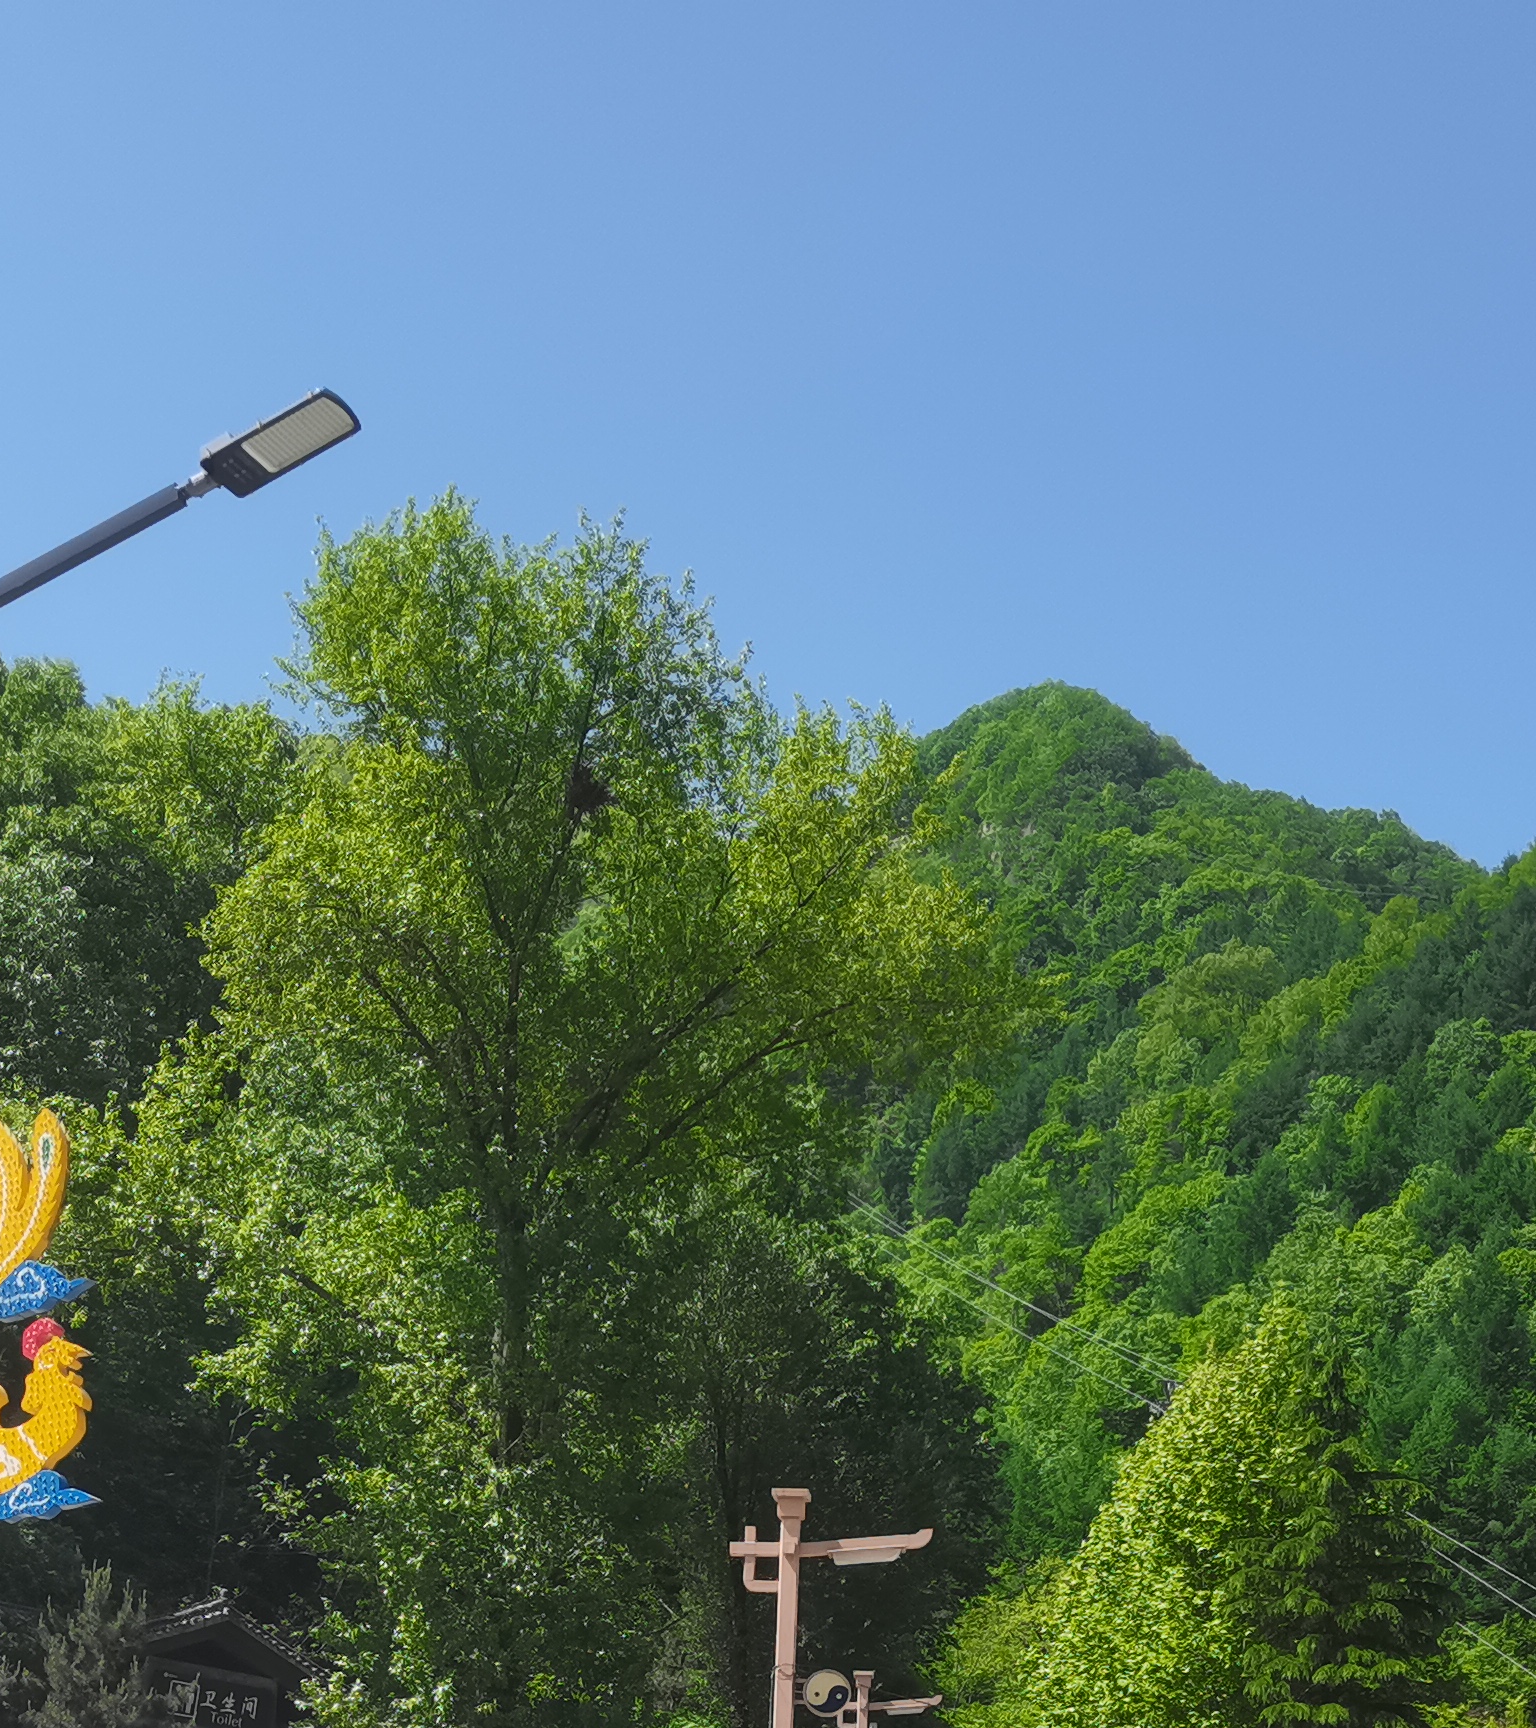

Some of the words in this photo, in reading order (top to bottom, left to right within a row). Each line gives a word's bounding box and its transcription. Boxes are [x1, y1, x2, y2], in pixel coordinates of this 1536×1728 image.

[200, 1690, 258, 1719] 卫生间
[210, 1711, 242, 1728] Toilet
